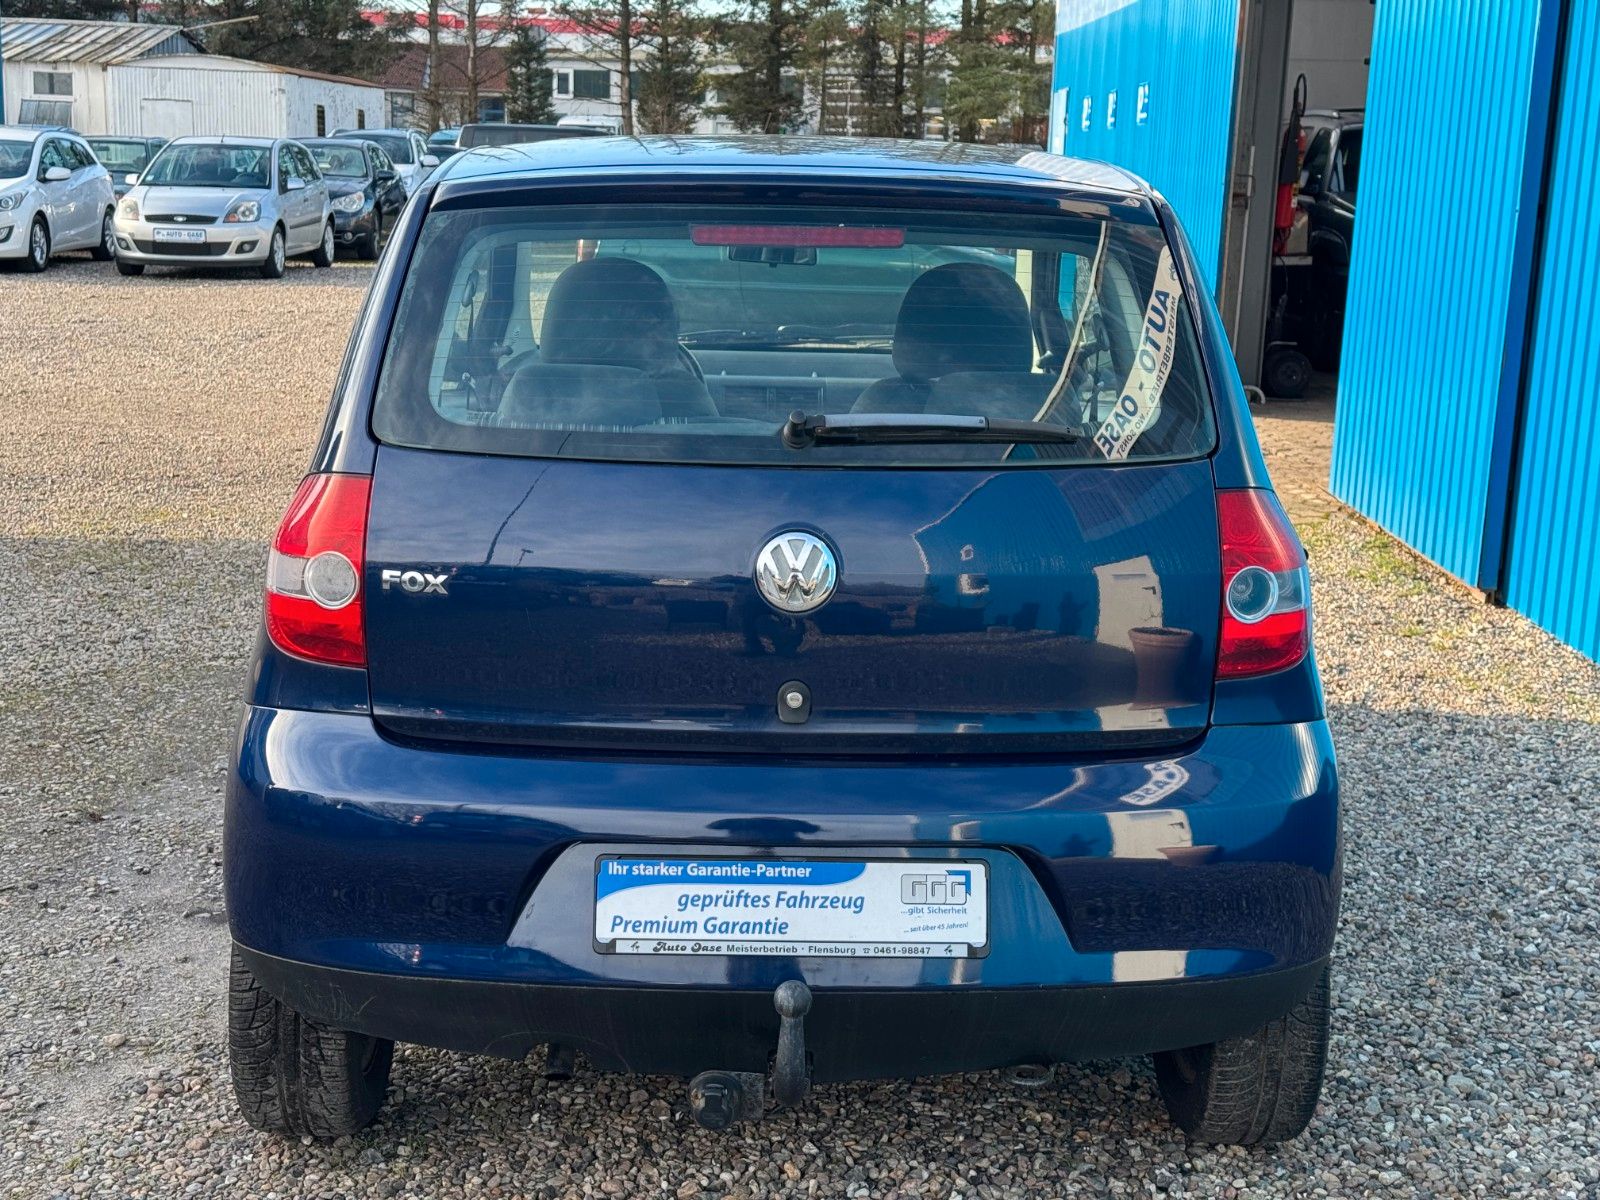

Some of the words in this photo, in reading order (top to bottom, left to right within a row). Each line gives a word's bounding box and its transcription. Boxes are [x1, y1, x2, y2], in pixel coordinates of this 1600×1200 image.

[756, 532, 836, 611] VW
[381, 569, 449, 595] FOX
[608, 862, 629, 876] Ihr
[631, 862, 683, 877] starker
[687, 863, 812, 878] Garantie-Partner
[677, 888, 770, 913] geprüftes
[774, 890, 865, 914] Fahrzeug
[926, 905, 967, 915] Sicherheit
[610, 915, 698, 934] Premium
[703, 915, 789, 935] Garantie
[726, 943, 798, 954] Meisterbetrieb
[808, 945, 857, 957] Flensburg
[873, 945, 932, 955] 0461-98847
